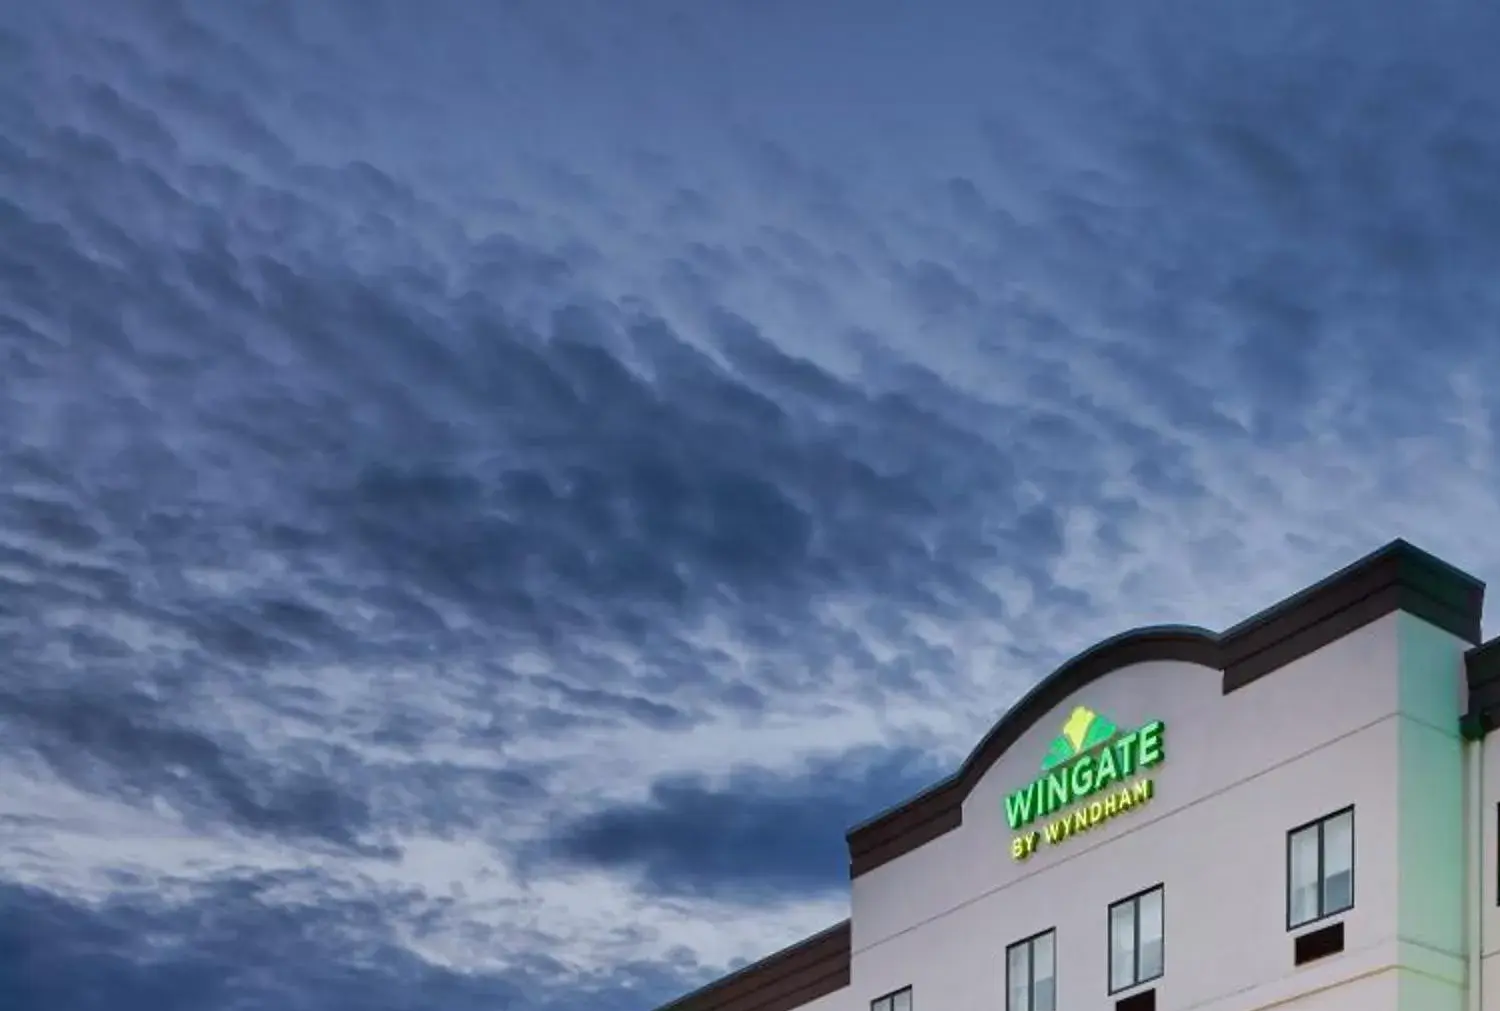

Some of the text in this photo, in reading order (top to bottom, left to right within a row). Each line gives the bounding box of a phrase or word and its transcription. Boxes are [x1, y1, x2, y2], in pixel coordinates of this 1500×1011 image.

[1005, 720, 1164, 829] WINGATE
[1012, 779, 1153, 858] BY WYNDHAM
